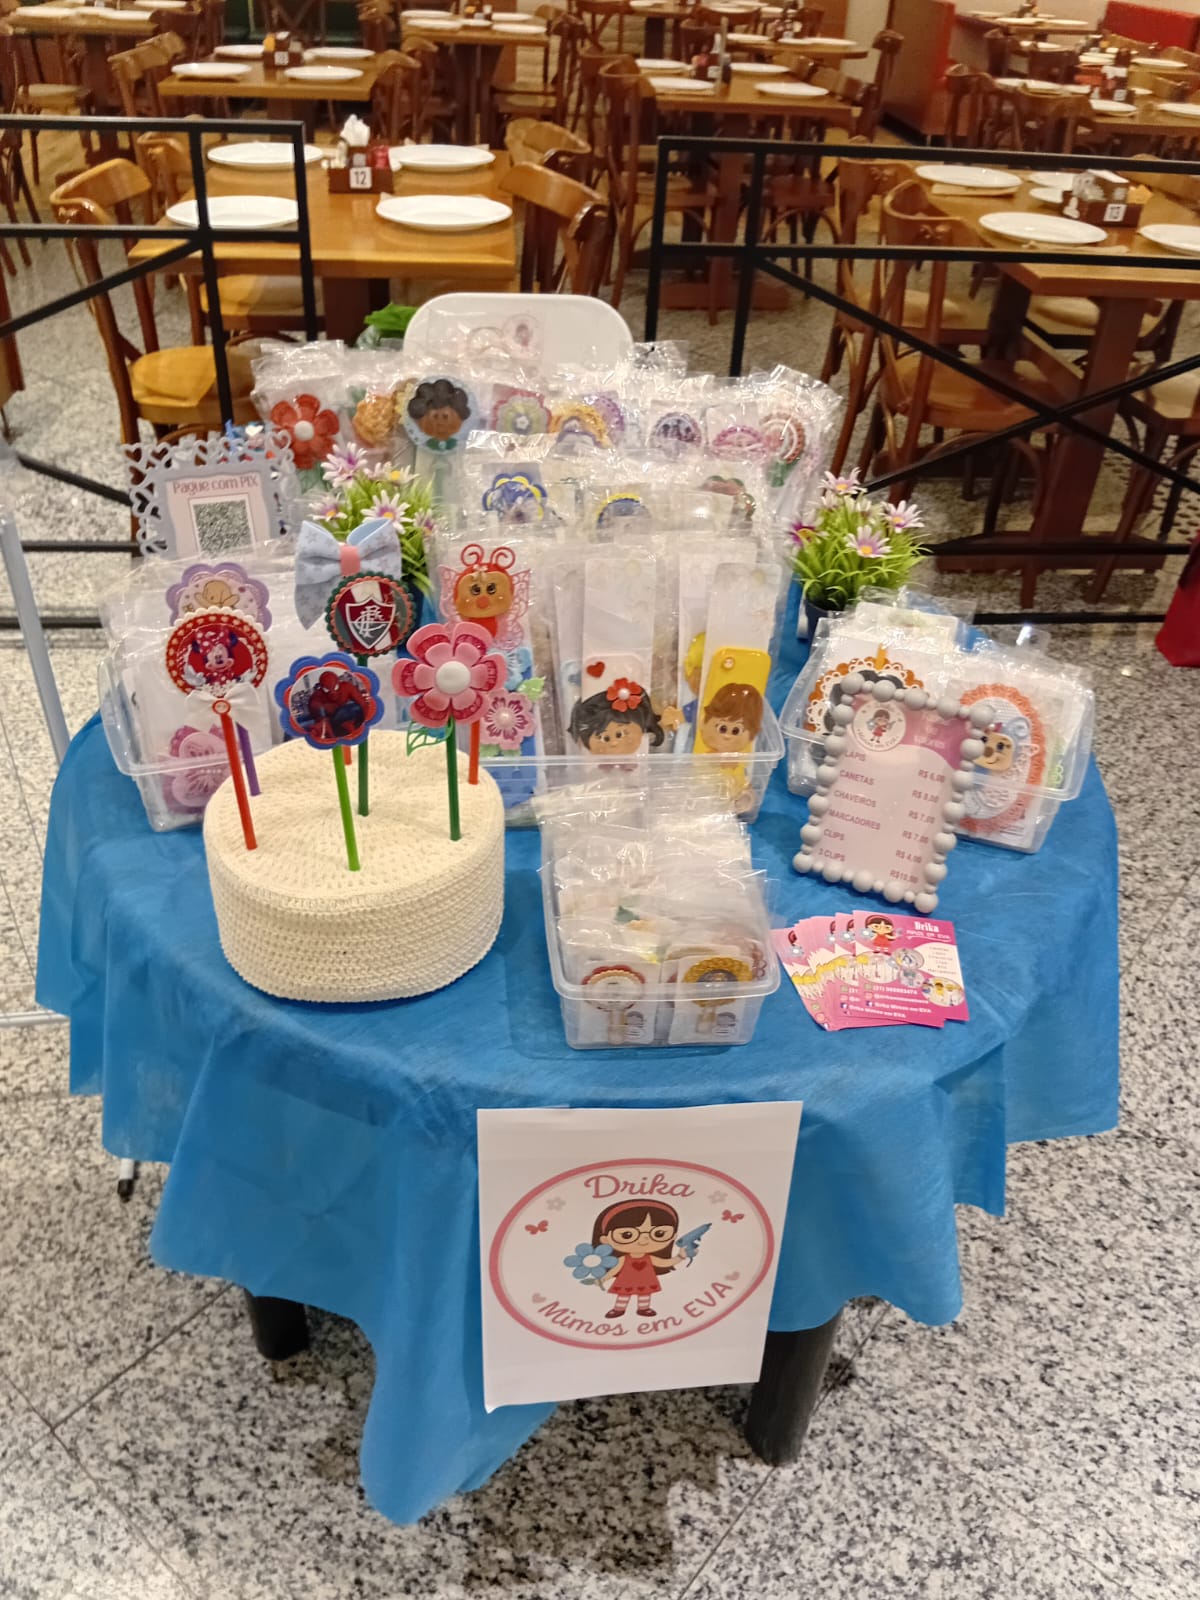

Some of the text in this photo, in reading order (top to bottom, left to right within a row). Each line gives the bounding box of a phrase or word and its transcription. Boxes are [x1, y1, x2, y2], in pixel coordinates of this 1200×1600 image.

[354, 171, 367, 185] 12
[173, 481, 209, 495] Pague
[211, 478, 238, 490] com
[840, 769, 875, 786] CANETAS
[834, 790, 877, 808] CHAVEIROS
[828, 808, 881, 830] MARCADORES
[823, 828, 845, 841] CLIPS
[824, 849, 846, 862] CLIPS
[584, 1173, 695, 1199] Drika
[538, 1281, 733, 1336] Mimos em EVA
